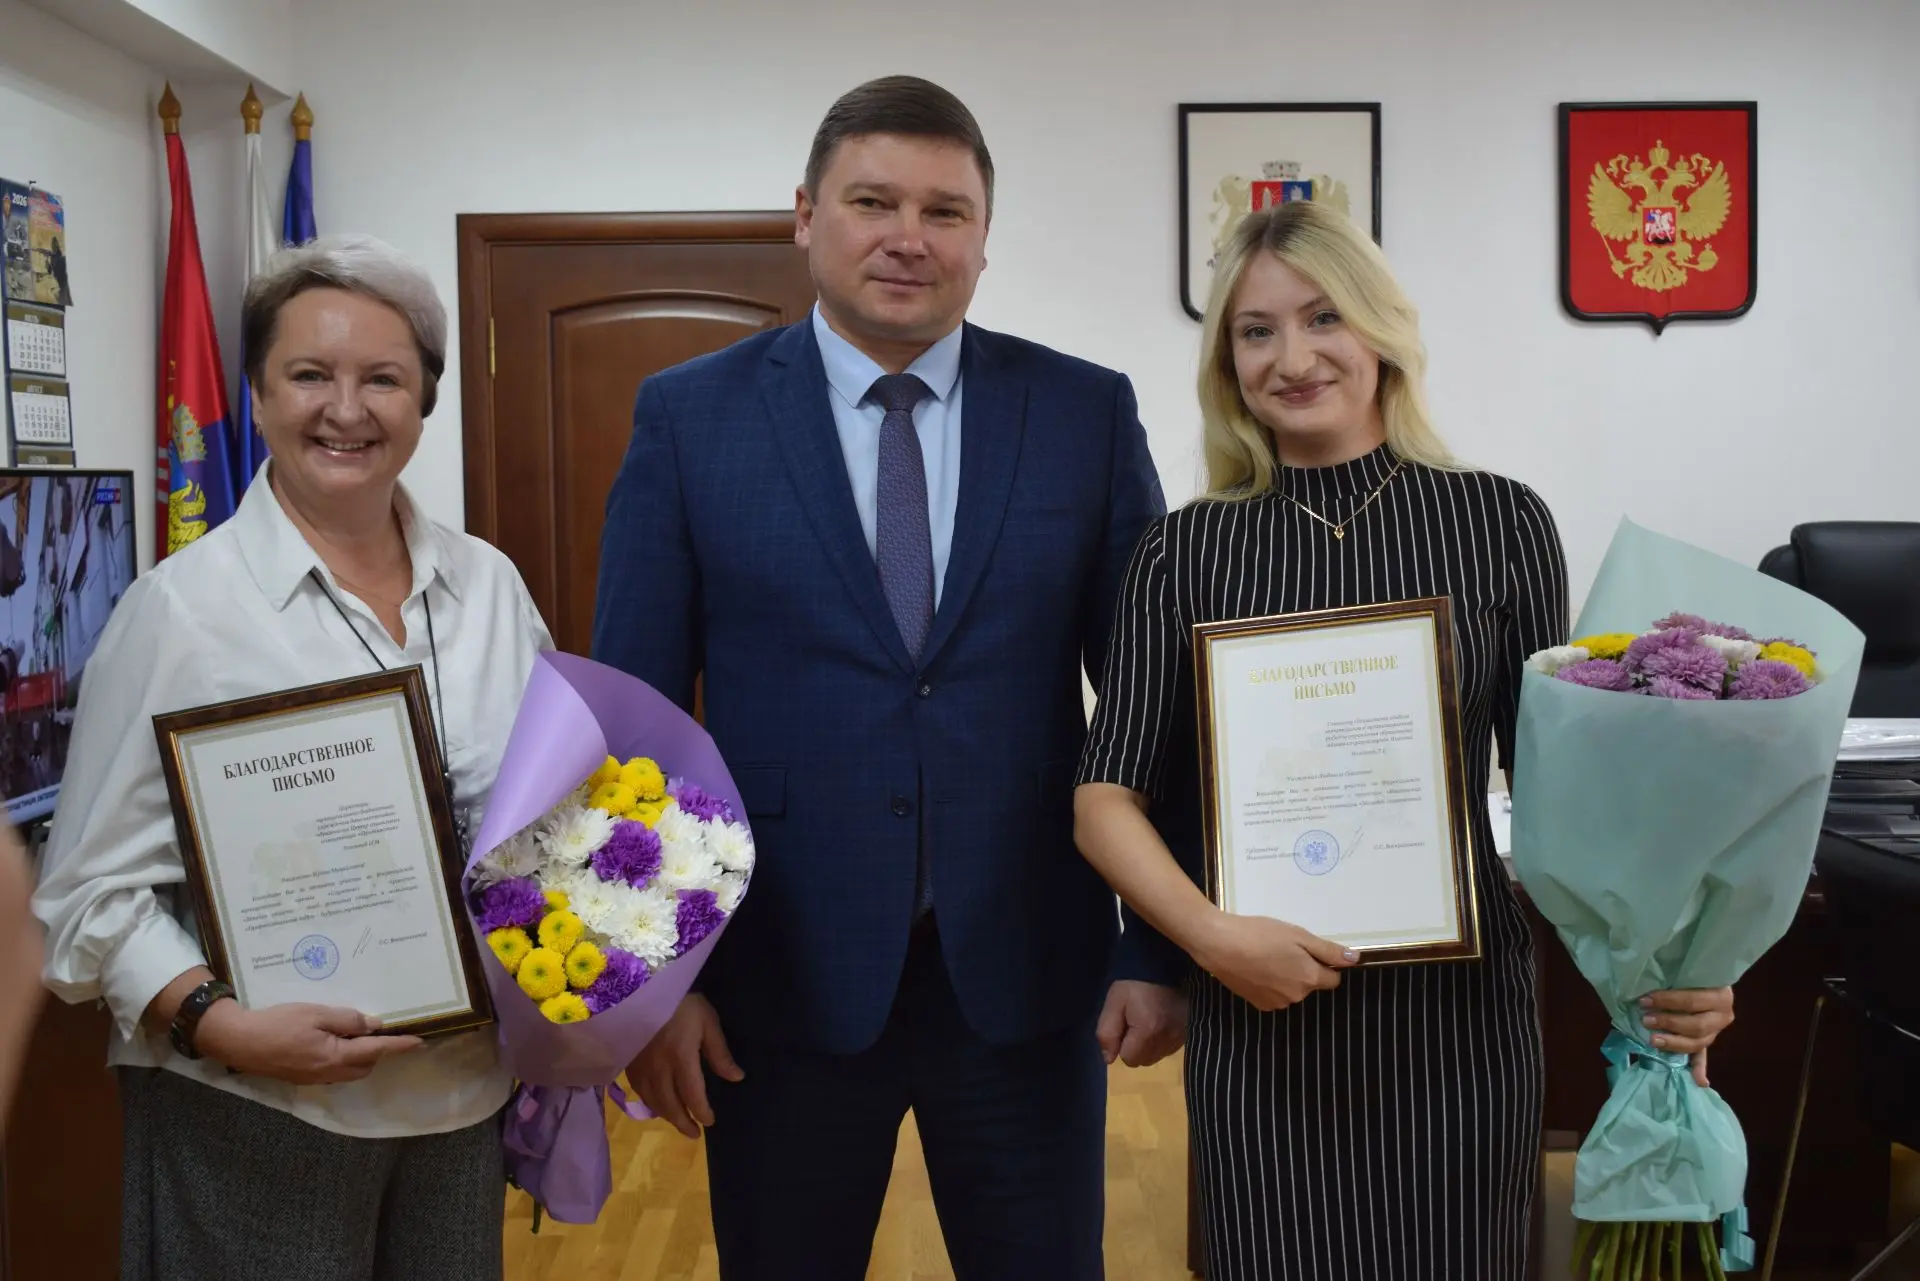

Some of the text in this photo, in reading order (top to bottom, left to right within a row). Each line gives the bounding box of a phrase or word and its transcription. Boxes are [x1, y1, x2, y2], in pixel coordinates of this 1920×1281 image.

[1294, 681, 1356, 700] ПИСЬМО
[223, 737, 376, 779] БЛАГОДАРСТВЕННОЕ
[272, 767, 336, 792] ПИСЬМО
